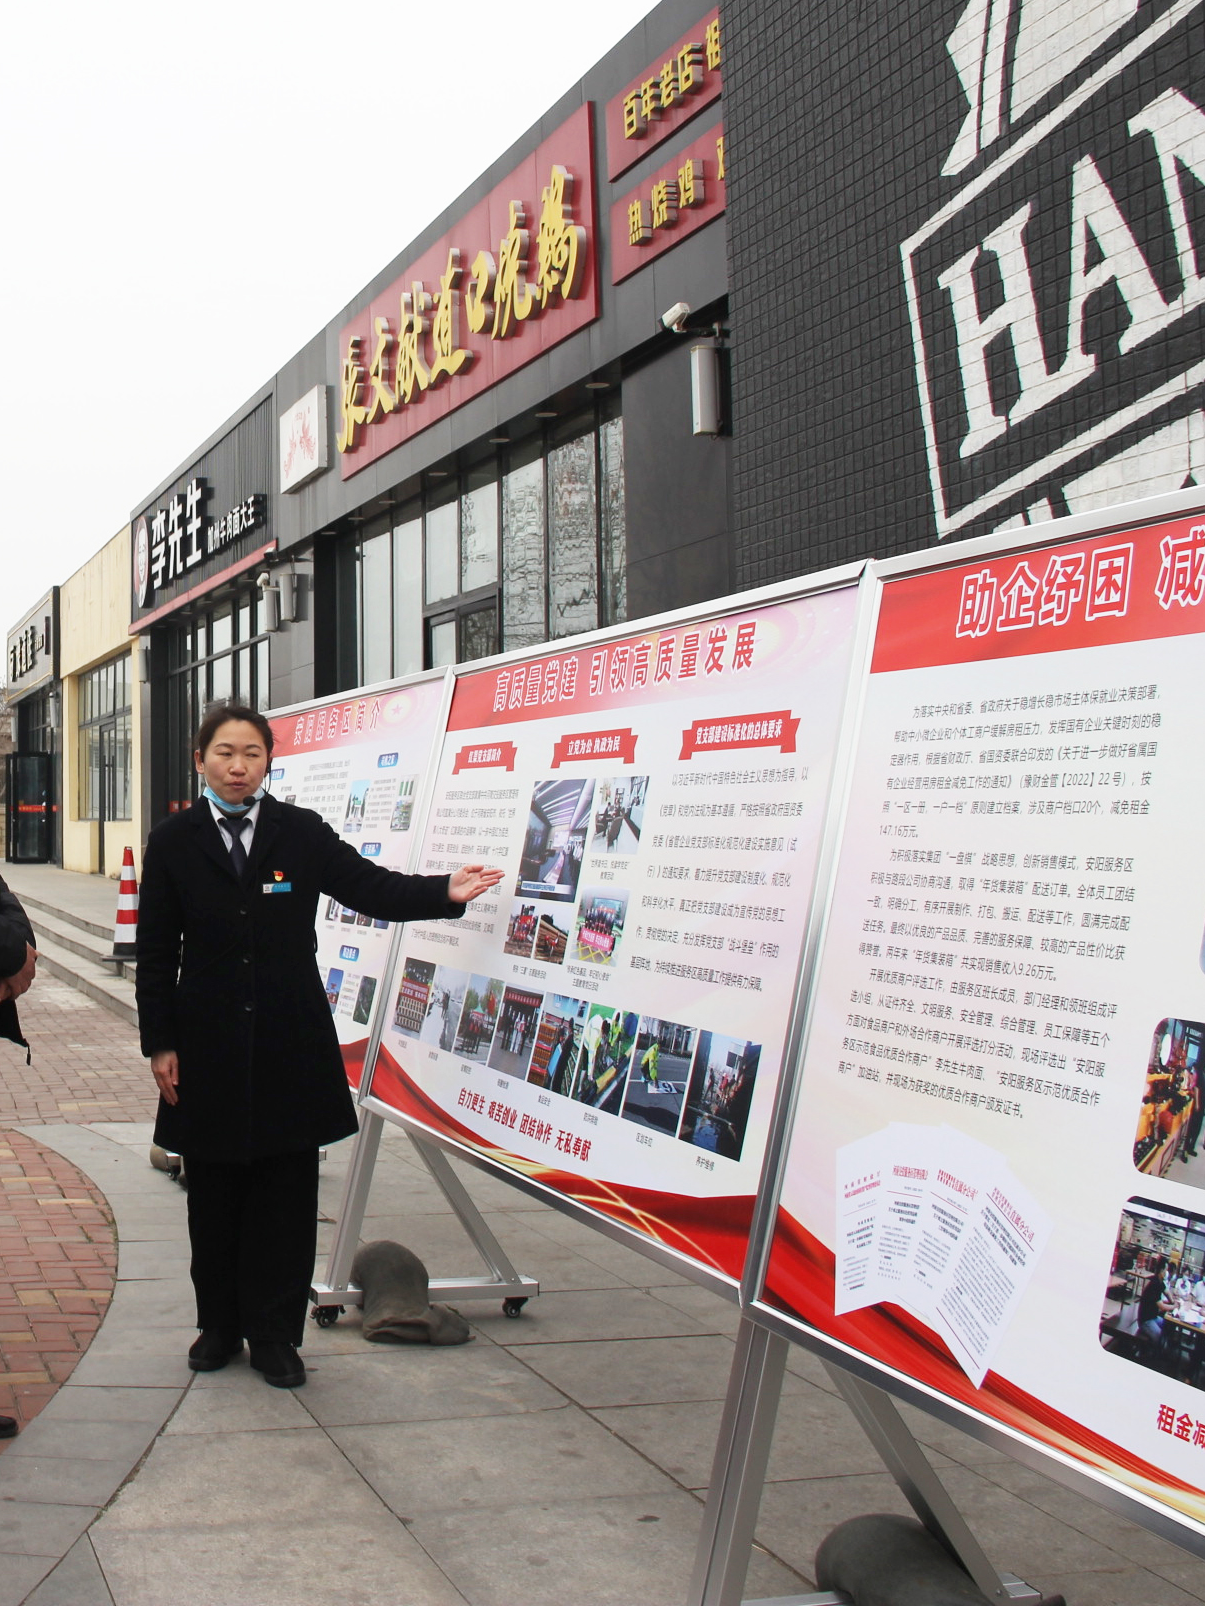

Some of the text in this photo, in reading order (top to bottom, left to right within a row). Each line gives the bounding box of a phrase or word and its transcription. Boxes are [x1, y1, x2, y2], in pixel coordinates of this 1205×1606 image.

[623, 43, 699, 139] 百年老店
[151, 478, 203, 591] 李先生
[207, 495, 255, 555] 加州牛肉面大王
[955, 525, 1205, 638] 助企纾困 减
[492, 620, 758, 712] 高质量党建 引领高质量发展
[567, 735, 621, 756] 立党为公 执政为民
[694, 717, 783, 745] 党支部建设标准化的总体要求
[457, 1085, 592, 1163] 自力更生 艰苦创业 团结协作 无私奉献
